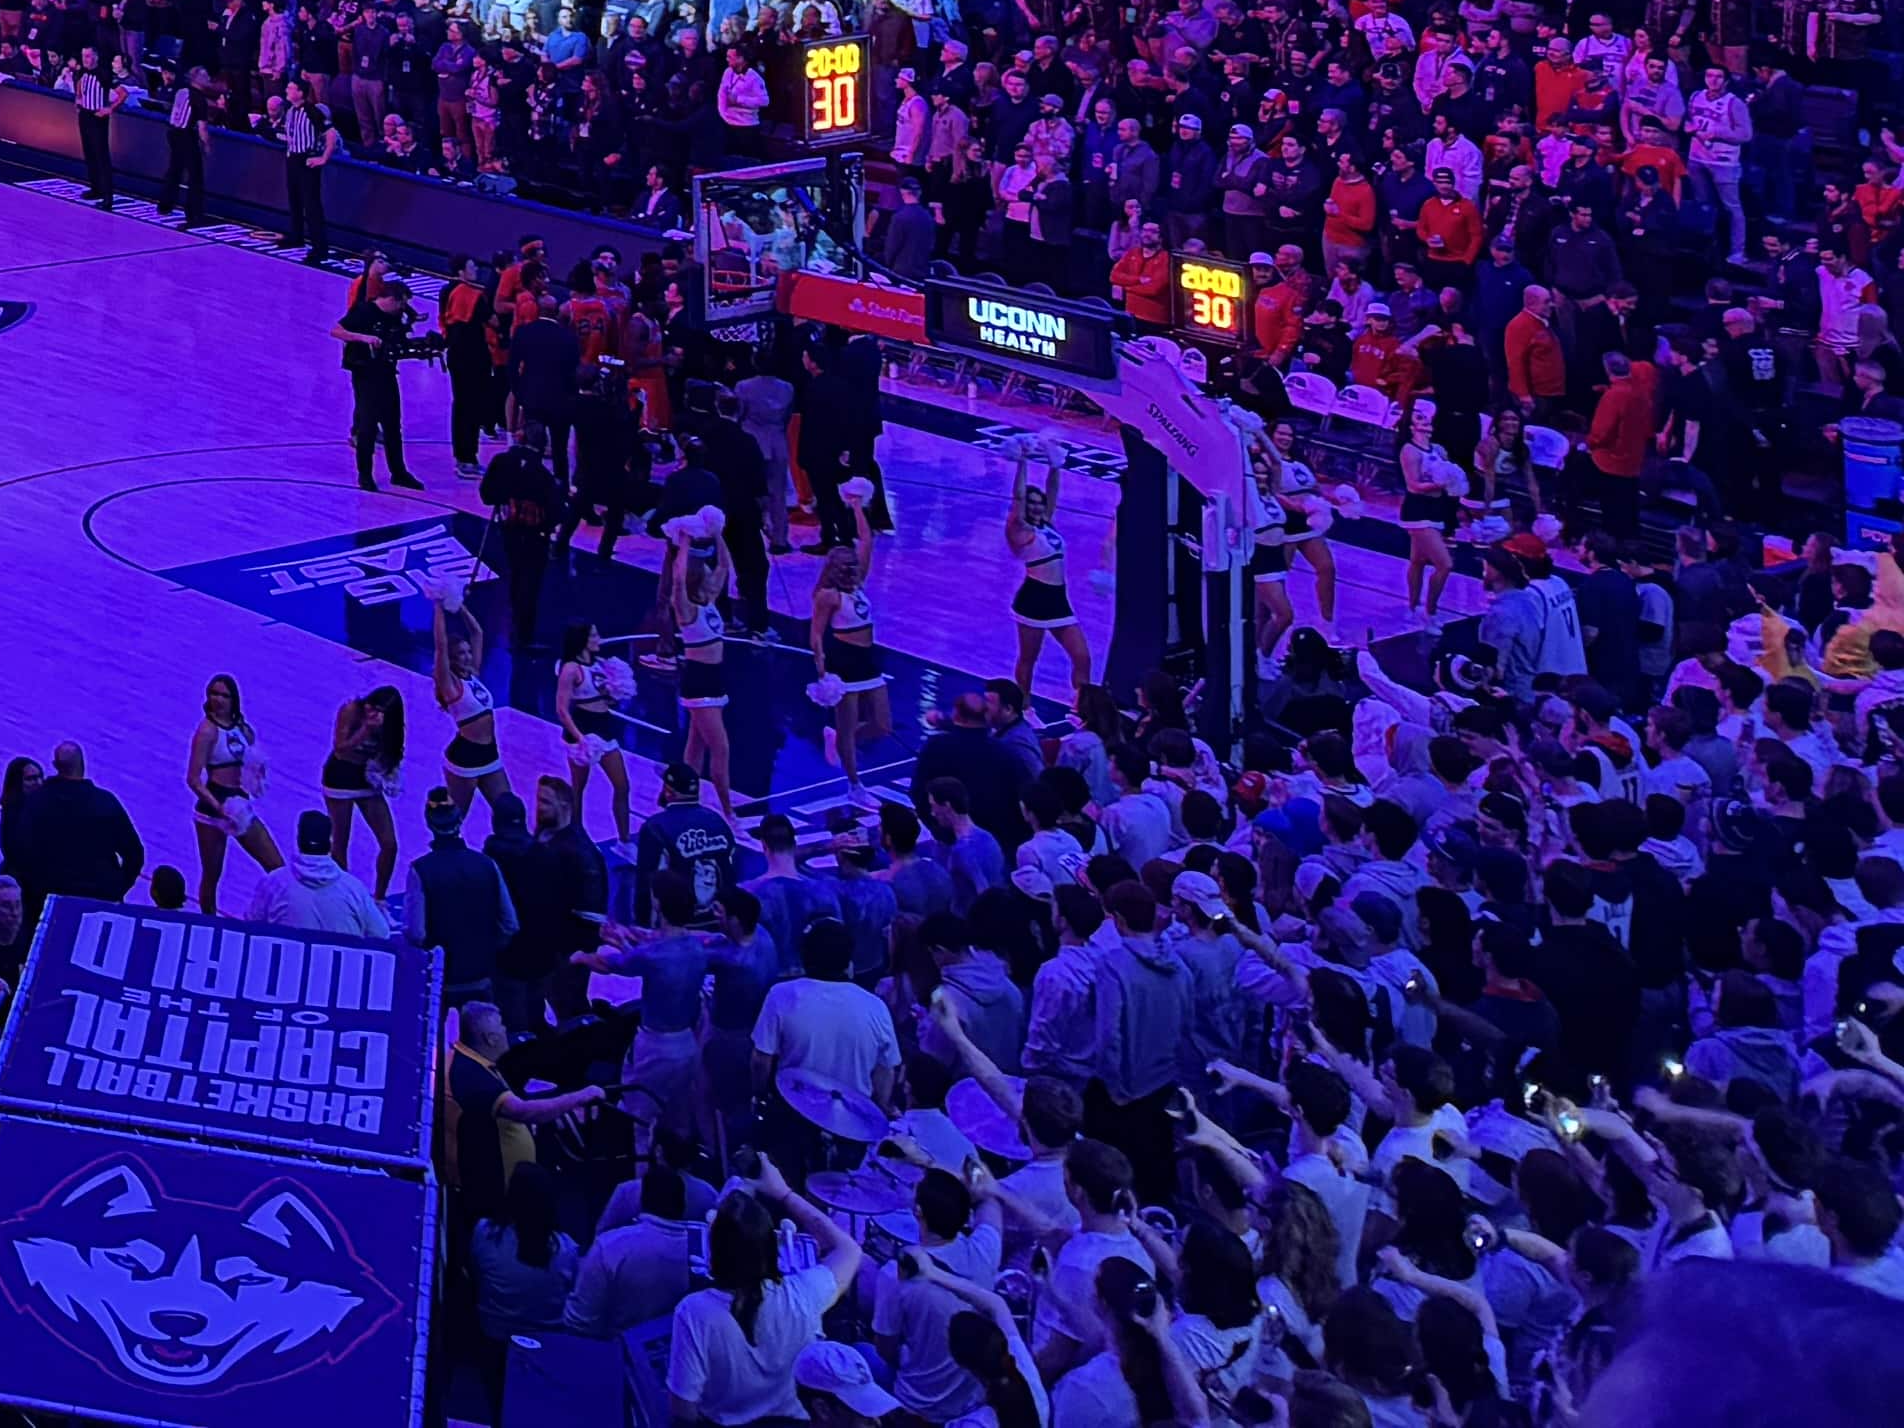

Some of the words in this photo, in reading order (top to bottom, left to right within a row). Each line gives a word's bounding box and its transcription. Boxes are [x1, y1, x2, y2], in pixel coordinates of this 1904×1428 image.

[806, 44, 861, 79] 20:00
[813, 75, 856, 131] 30
[1181, 263, 1242, 299] 20:00
[968, 297, 1067, 341] UCONN
[1193, 290, 1232, 330] 30
[980, 325, 1057, 357] HEALTH
[1148, 402, 1200, 456] SPALDING
[69, 911, 396, 1012] WORLD
[122, 989, 225, 1019] THE
[251, 1007, 330, 1026] OF
[61, 989, 389, 1091] CAPITAL
[44, 1045, 383, 1135] BASKETBALL
